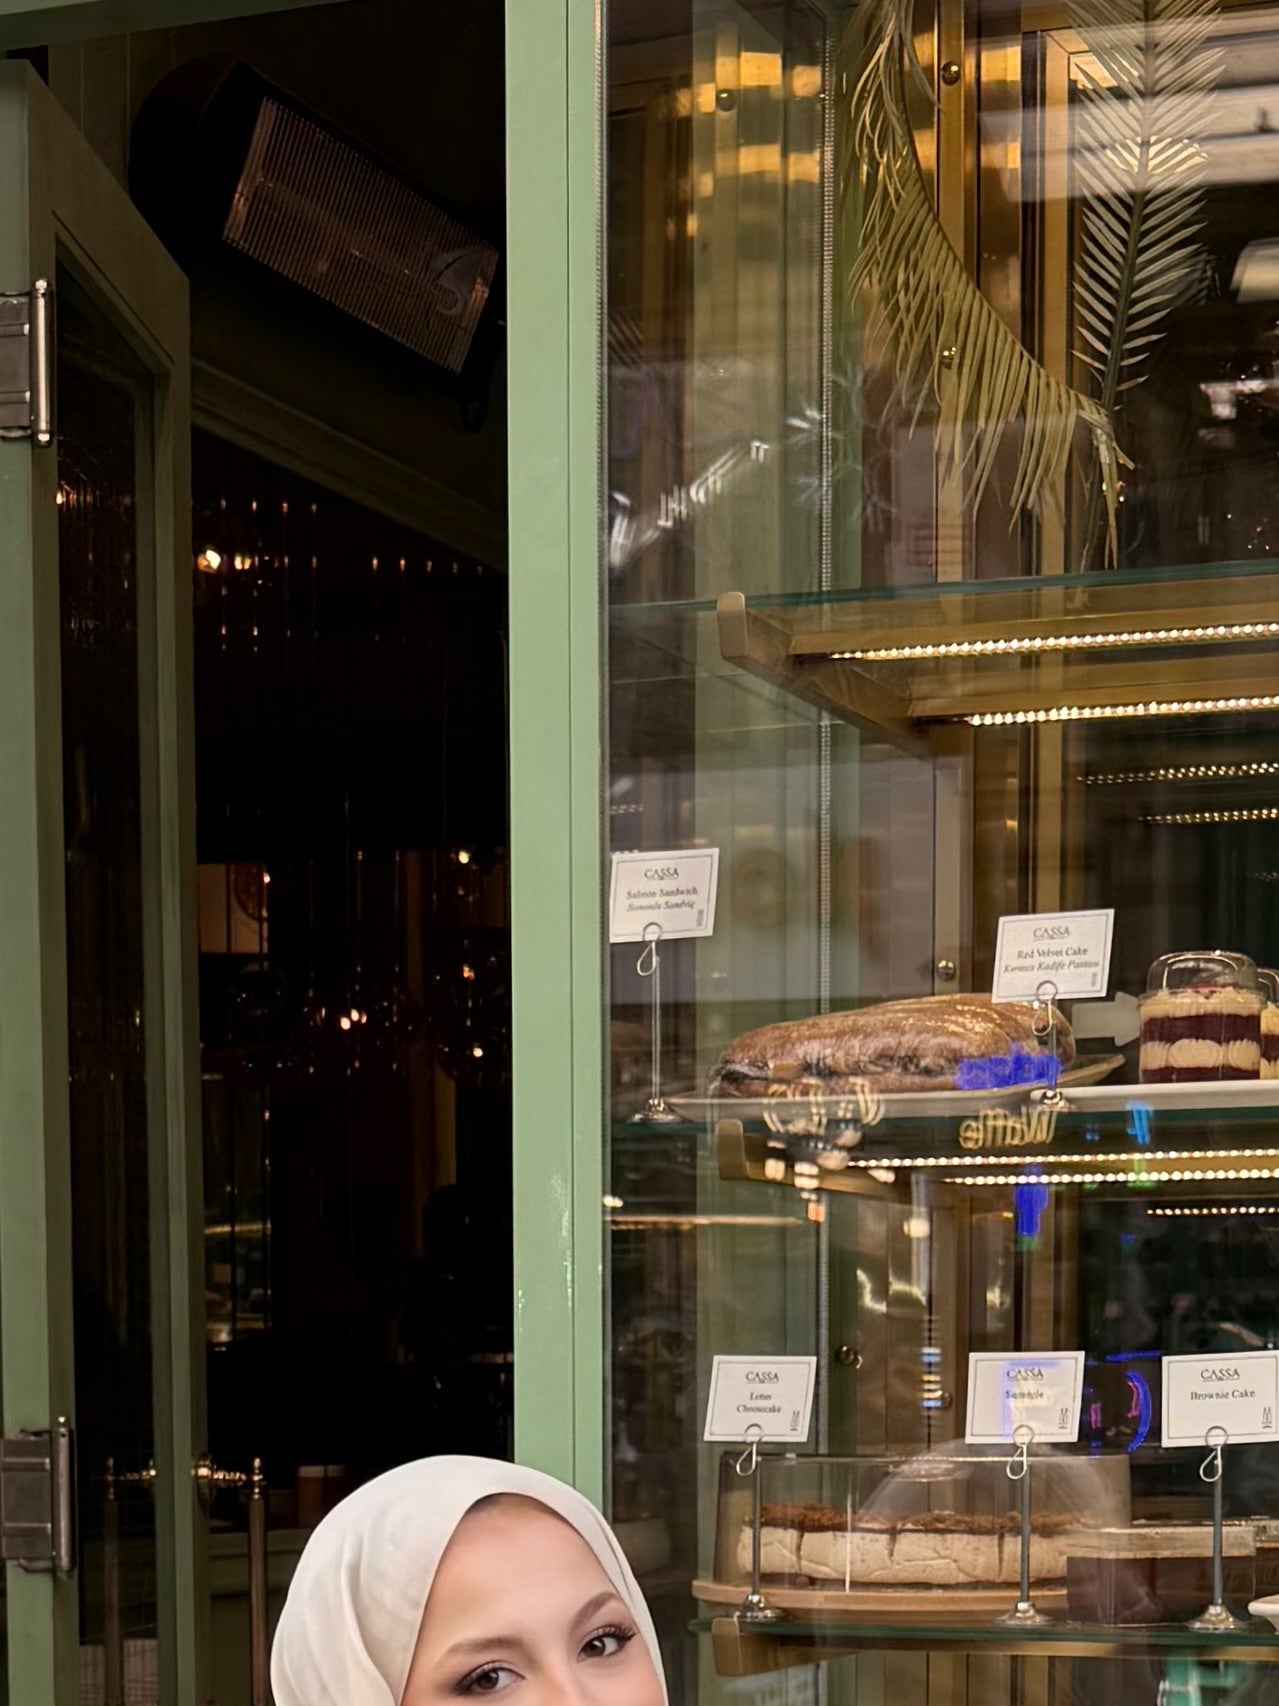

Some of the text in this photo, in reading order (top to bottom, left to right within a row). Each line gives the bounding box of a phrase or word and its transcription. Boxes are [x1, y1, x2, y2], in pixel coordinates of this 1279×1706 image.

[644, 867, 679, 880] CASSA
[1033, 926, 1070, 939] CASSA
[1017, 947, 1088, 960] Red Velvet Cake
[745, 1371, 779, 1384] CASSA
[1006, 1368, 1043, 1381] CASSA
[1200, 1368, 1240, 1381] CASSA
[1190, 1389, 1255, 1401] Brownie Cake
